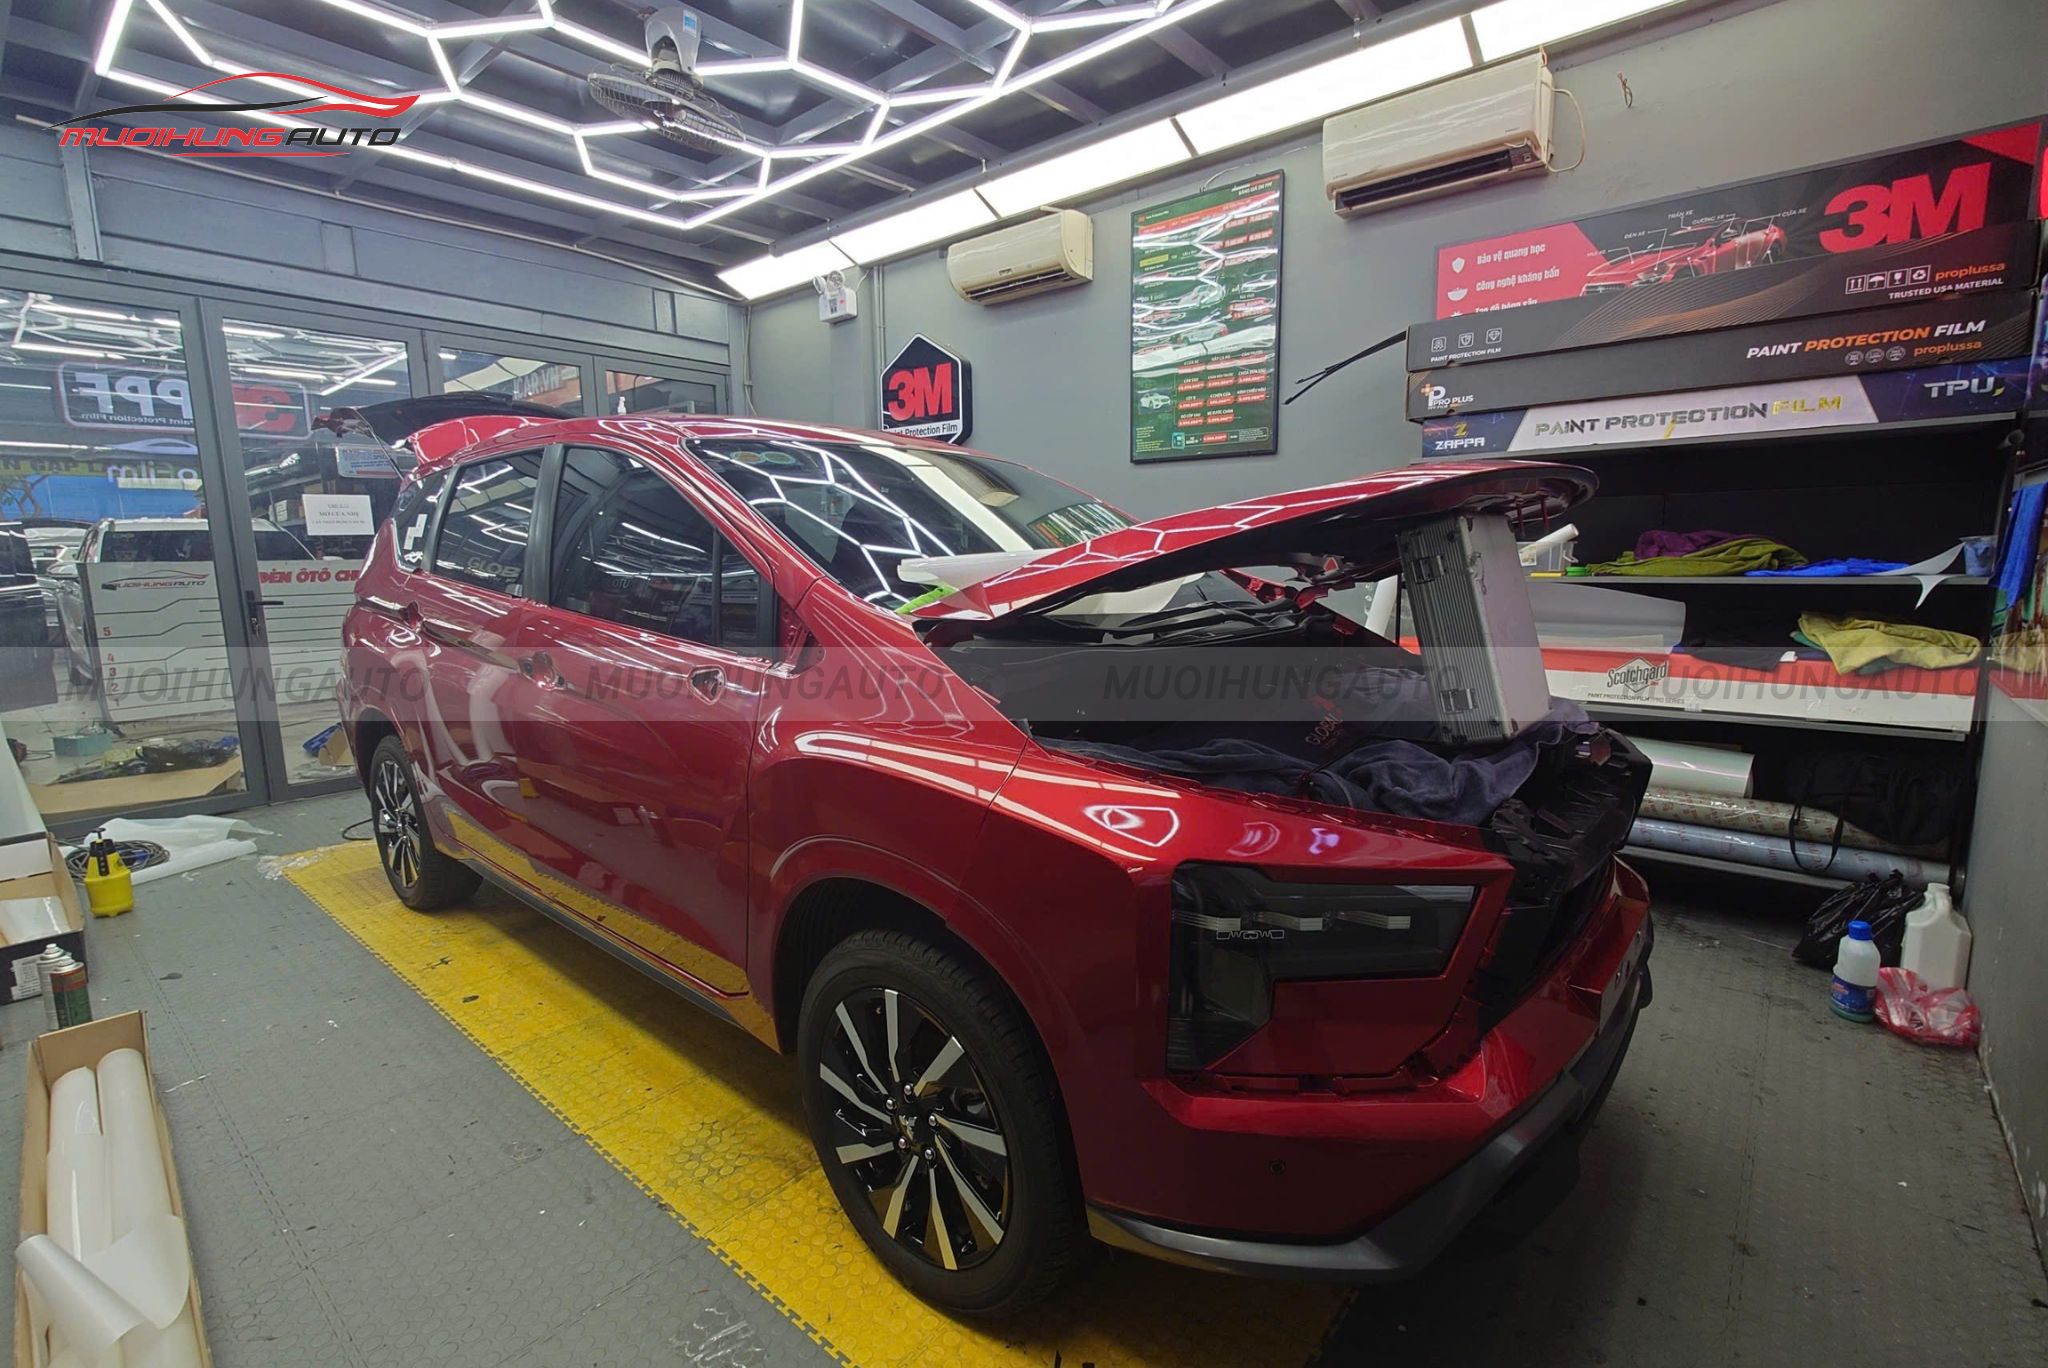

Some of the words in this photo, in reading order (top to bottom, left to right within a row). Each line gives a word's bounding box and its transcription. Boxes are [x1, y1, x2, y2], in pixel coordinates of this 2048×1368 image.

[1819, 162, 1992, 254] 3M
[1935, 261, 2006, 282] proplussa
[1889, 287, 1932, 300] TRUSTED
[1933, 284, 1953, 294] USA
[1955, 277, 2004, 290] MATERIAL
[1747, 342, 1802, 359] PAINT
[1804, 326, 1930, 352] PROTECTION
[1934, 320, 1986, 338] FILM
[1913, 340, 1983, 358] proplussa
[1431, 355, 1448, 363] PAINT
[1449, 349, 1486, 360] PROTECTION
[1487, 347, 1502, 355] FILM
[888, 362, 952, 421] 3M
[1924, 377, 1995, 398] TPU
[1451, 394, 1474, 405] PLUS
[1535, 418, 1600, 437] PAINT
[1605, 403, 1768, 431] PROTECTION
[1772, 395, 1842, 417] FILM
[905, 425, 942, 437] Protection
[942, 423, 958, 434] Film
[1435, 437, 1485, 451] ZAPPA
[1607, 660, 1667, 688] Scotchgard
